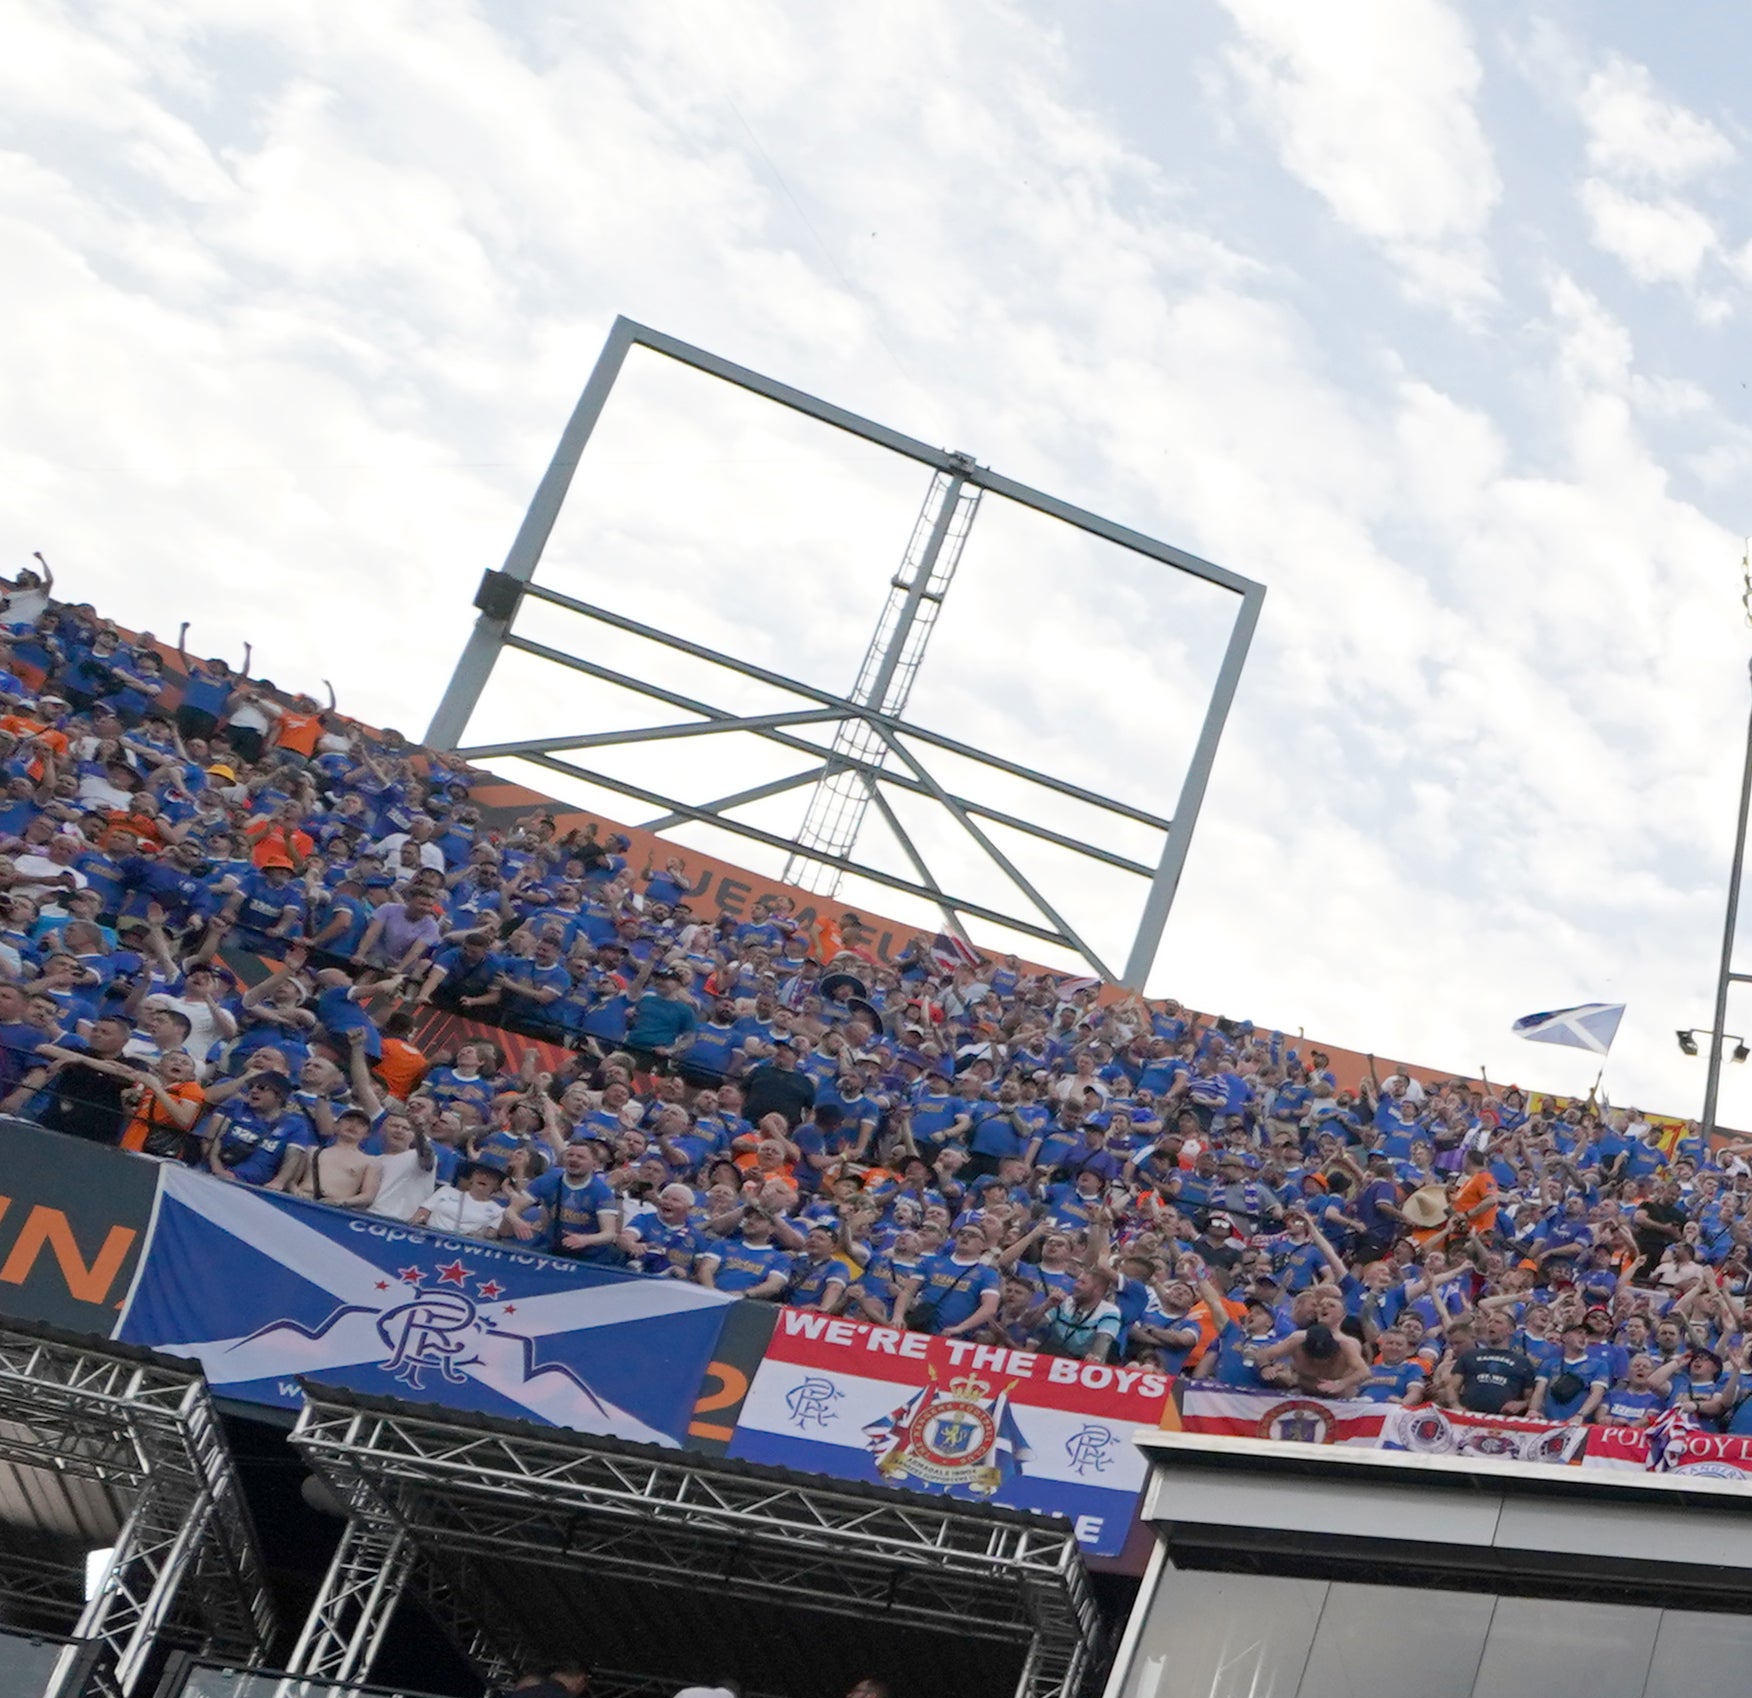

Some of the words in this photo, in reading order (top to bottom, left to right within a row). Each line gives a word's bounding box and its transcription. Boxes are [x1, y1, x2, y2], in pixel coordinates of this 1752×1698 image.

[784, 1312, 927, 1359] WE'RE
[945, 1339, 1034, 1378] THE
[1048, 1355, 1169, 1397] BOYS
